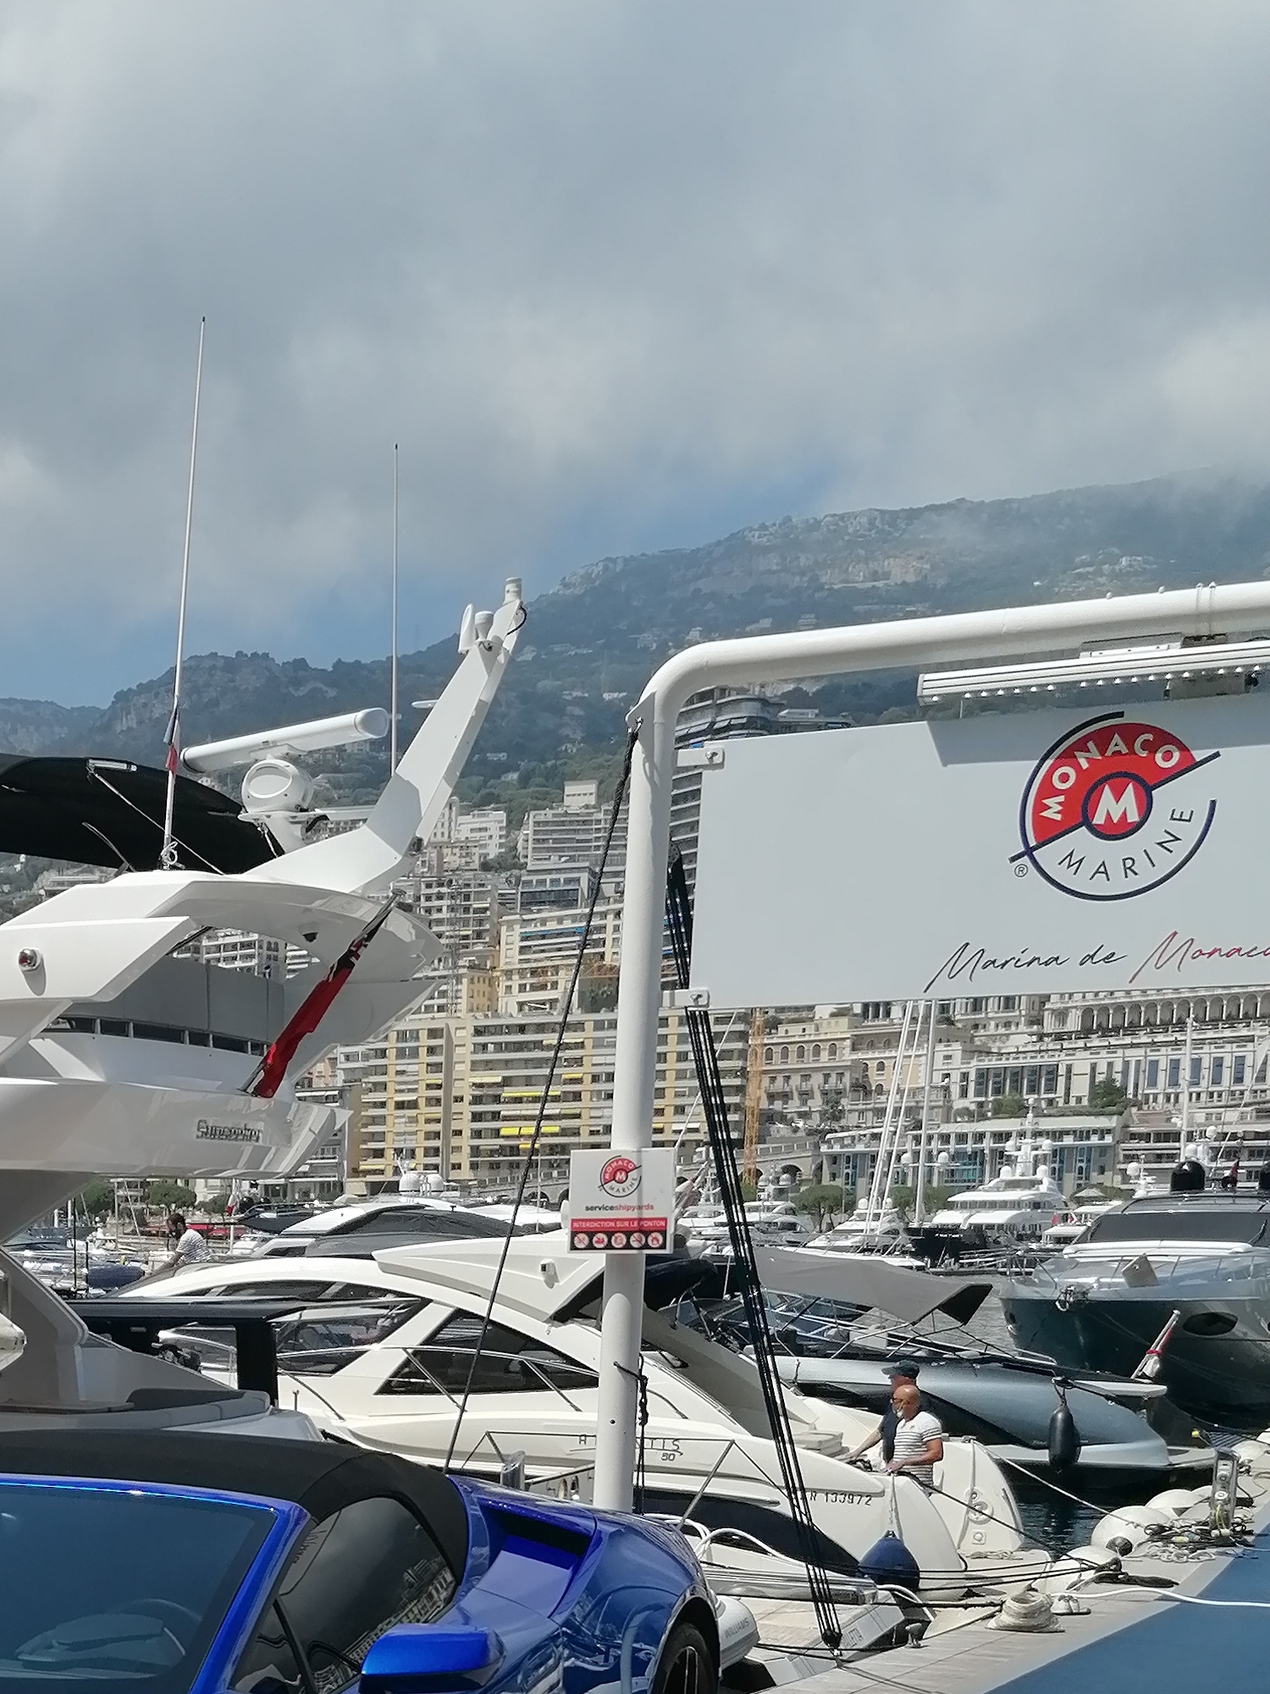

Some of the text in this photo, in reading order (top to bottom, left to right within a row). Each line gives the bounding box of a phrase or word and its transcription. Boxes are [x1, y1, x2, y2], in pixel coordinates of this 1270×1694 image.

[1039, 732, 1180, 821] MONACO
[1092, 782, 1140, 825] M
[1058, 808, 1194, 882] MARINE
[923, 941, 1070, 993] Marina
[1079, 944, 1128, 967] de
[604, 1160, 634, 1180] MONACO
[609, 1177, 638, 1194] MARINE
[661, 1452, 676, 1462] 50
[825, 1492, 872, 1506] 133972
[724, 1617, 750, 1639] WILLIAMS
